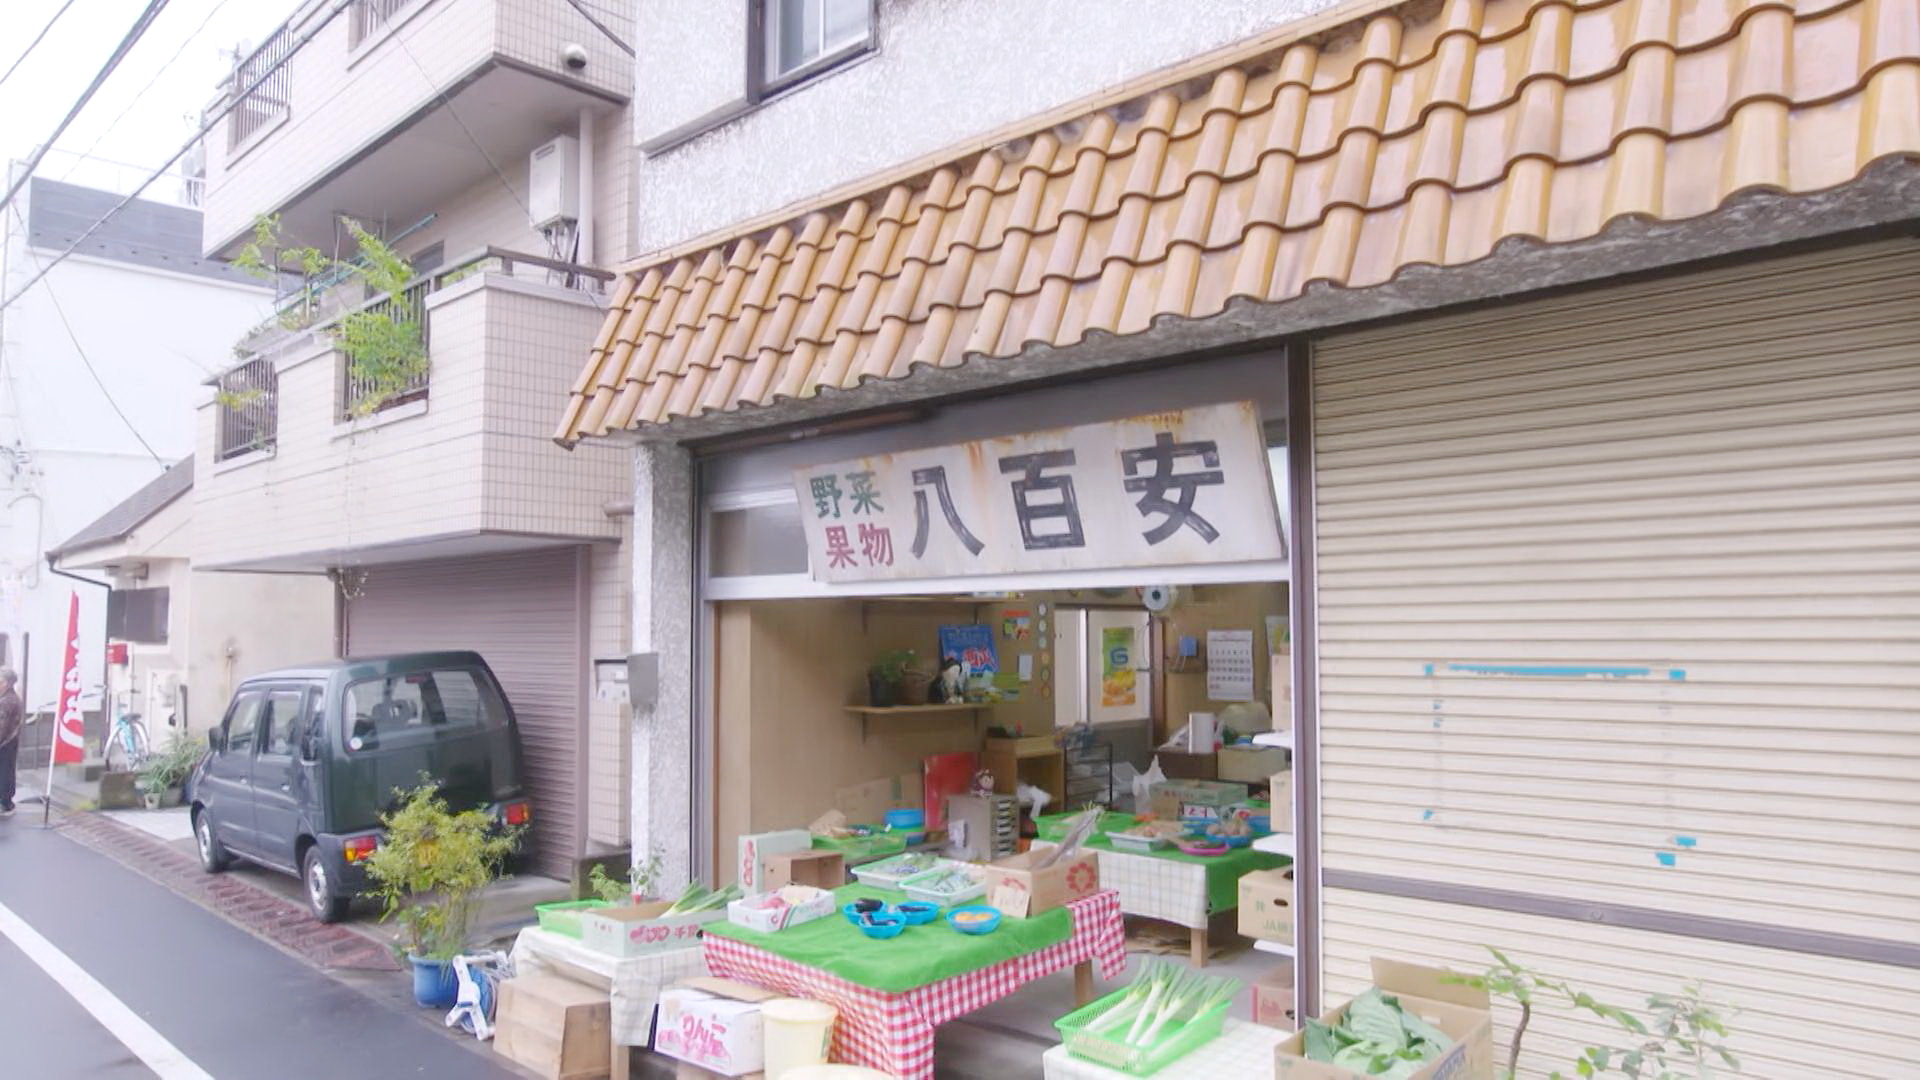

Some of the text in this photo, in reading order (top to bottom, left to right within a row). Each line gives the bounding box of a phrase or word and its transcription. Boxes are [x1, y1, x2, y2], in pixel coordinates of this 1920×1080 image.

[809, 469, 884, 518] 野菜
[911, 431, 1224, 559] 八百安
[825, 522, 894, 570] 果物
